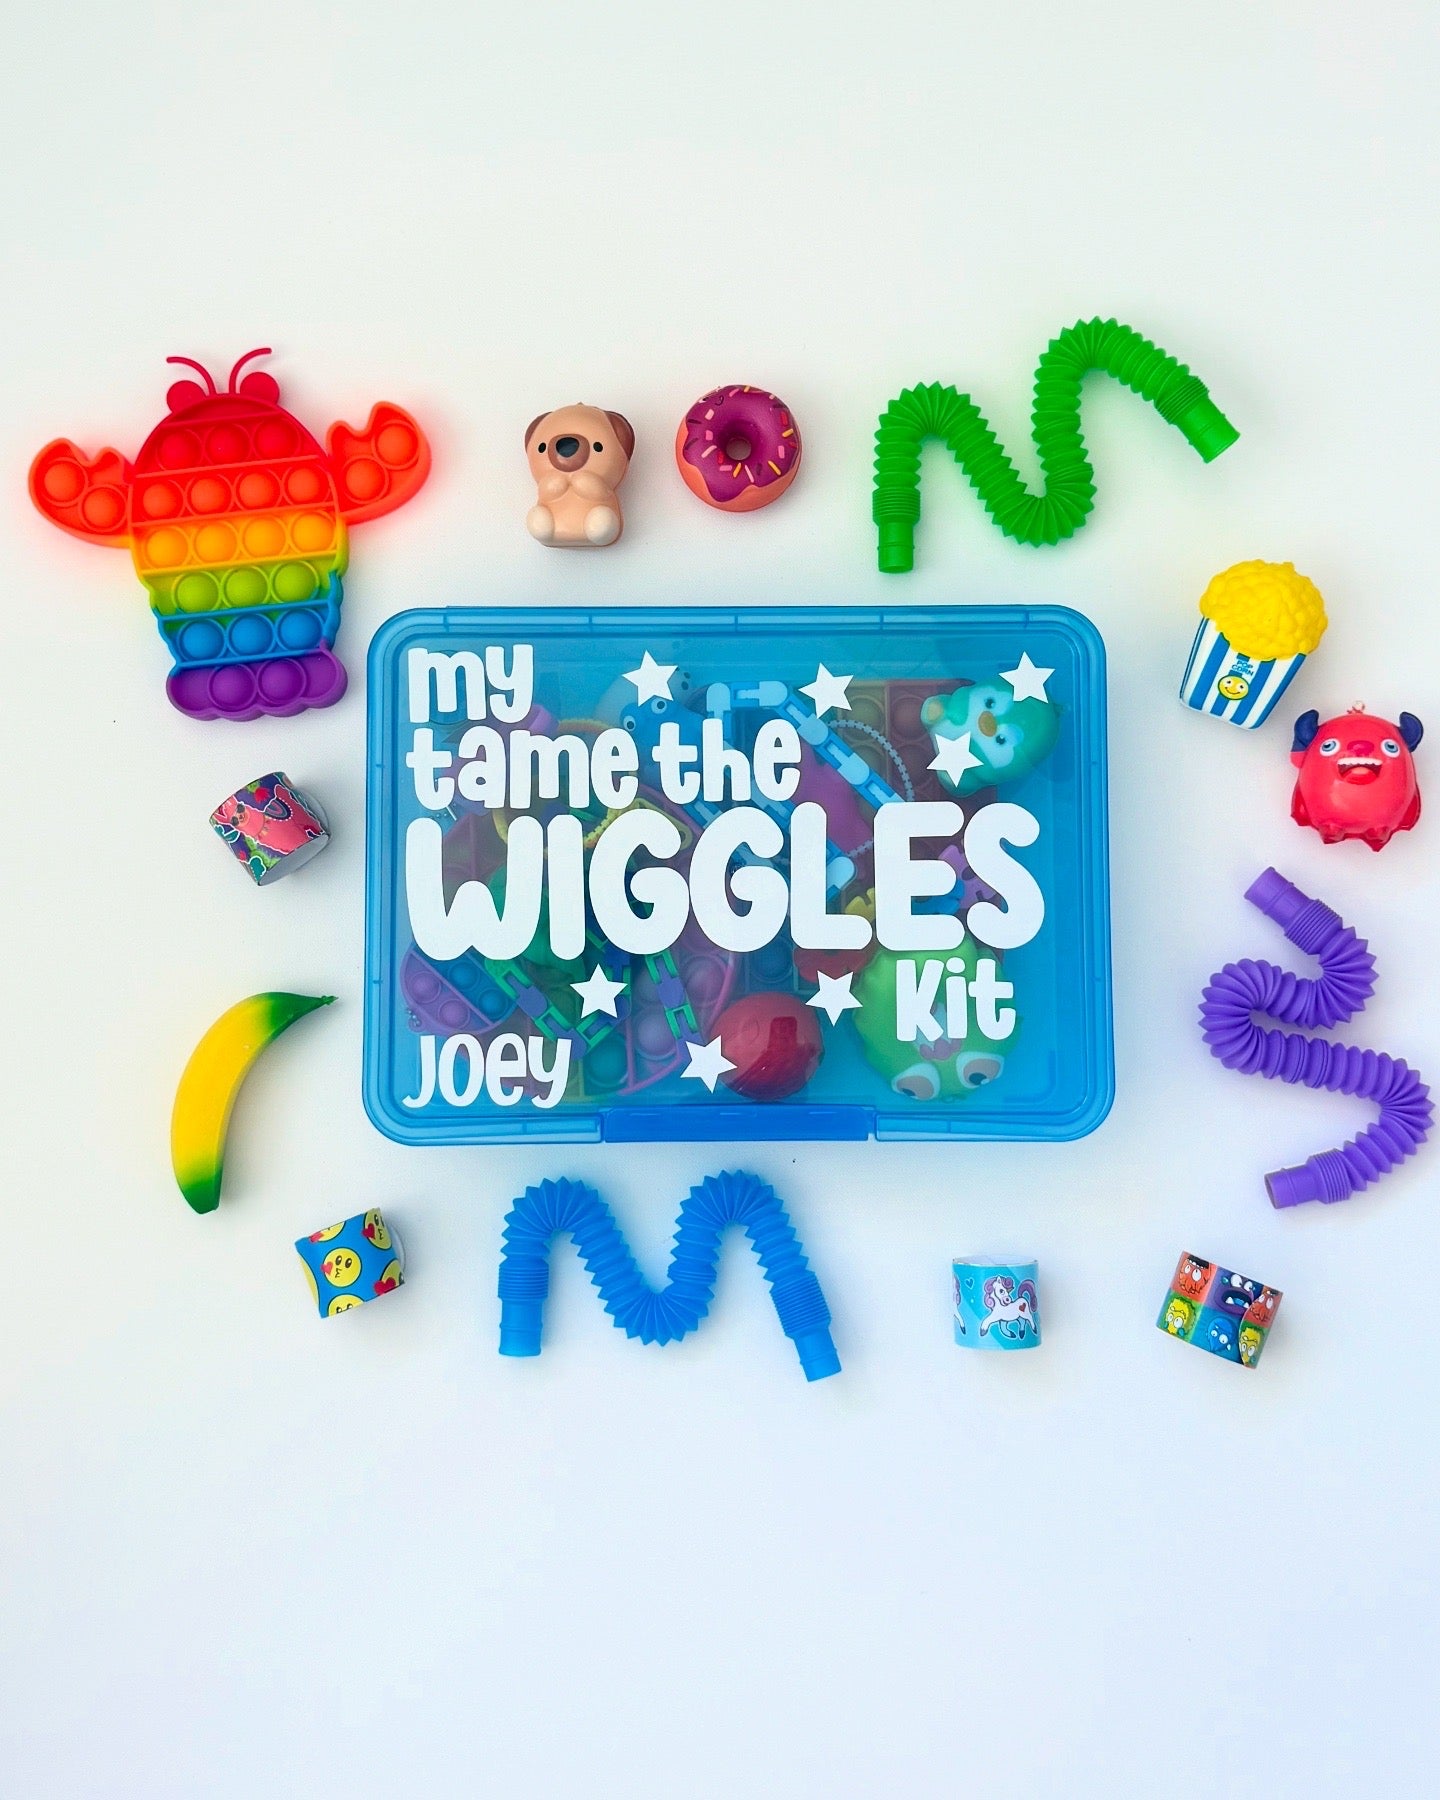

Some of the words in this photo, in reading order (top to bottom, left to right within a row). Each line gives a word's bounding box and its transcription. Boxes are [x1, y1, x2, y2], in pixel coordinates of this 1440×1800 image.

[408, 645, 533, 724] my
[1231, 664, 1254, 676] CORN
[1236, 659, 1254, 669] POP
[405, 726, 639, 811] tame
[652, 719, 802, 805] the
[405, 801, 1046, 961] WIGGLES
[896, 956, 1017, 1042] Kit
